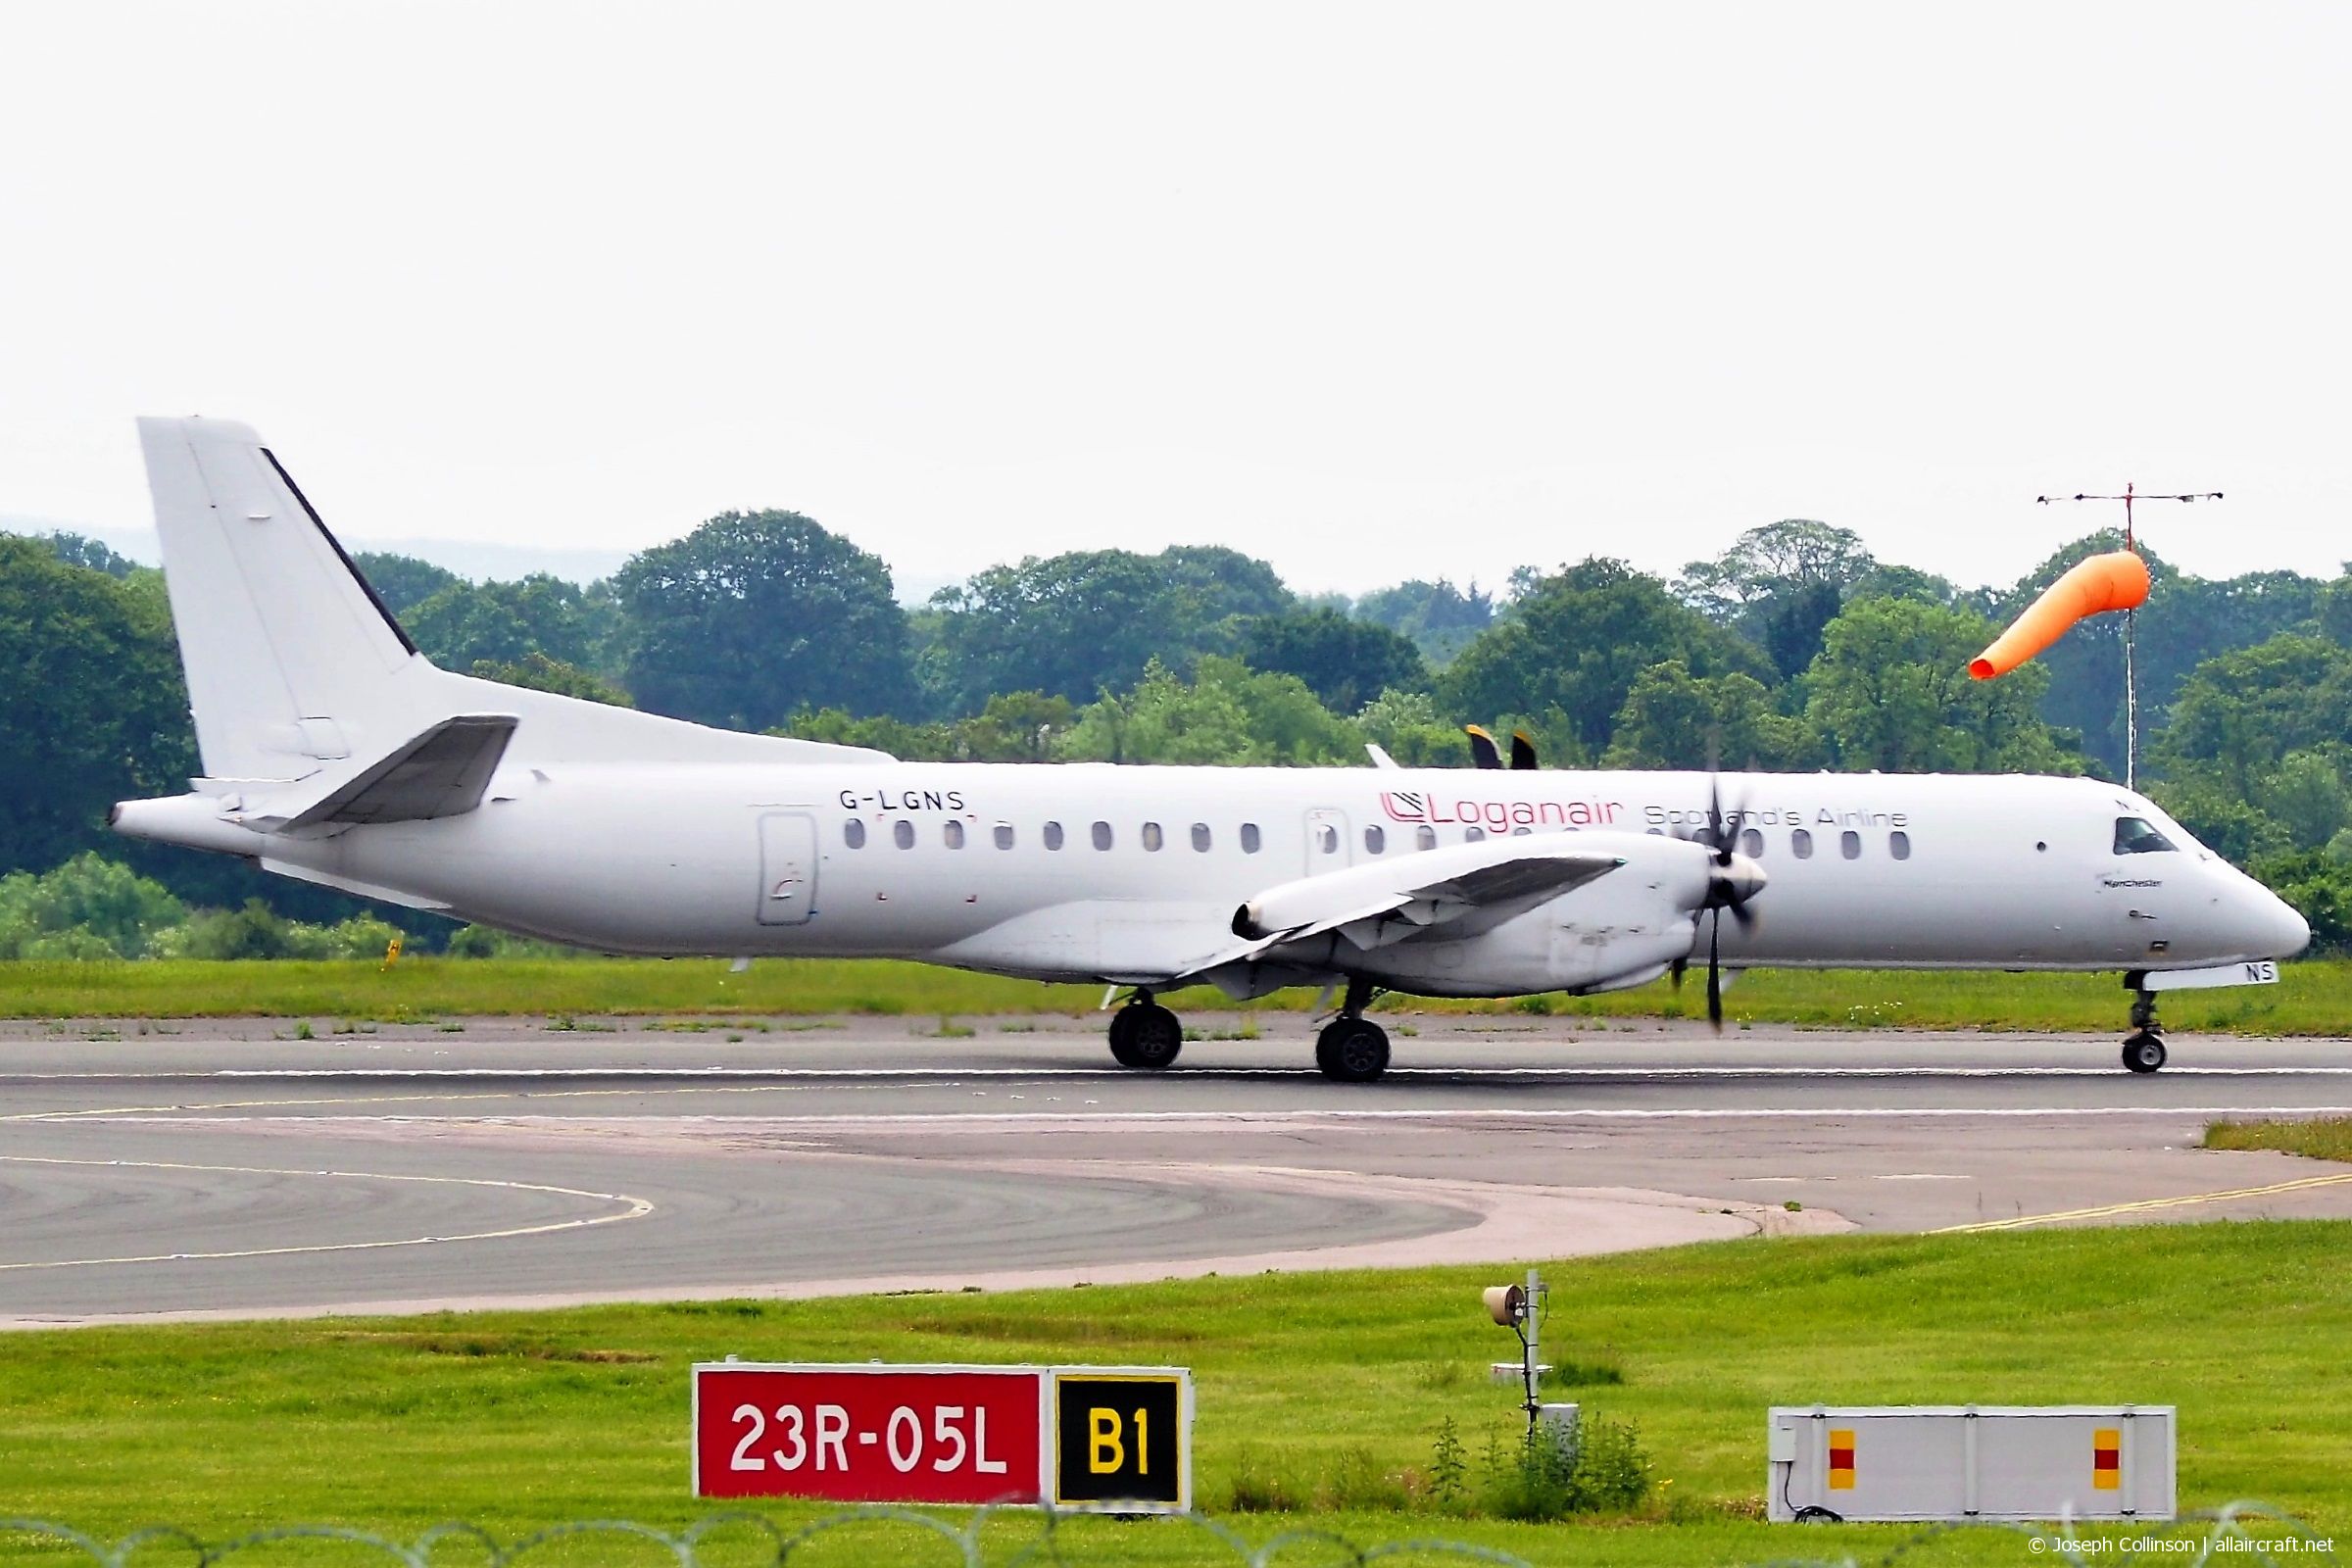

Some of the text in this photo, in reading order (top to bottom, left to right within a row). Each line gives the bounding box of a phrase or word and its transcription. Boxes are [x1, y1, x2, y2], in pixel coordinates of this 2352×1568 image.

[840, 790, 963, 810] G-LGNS
[1427, 793, 1623, 833] Loganair
[1817, 808, 1908, 827] Airline
[2246, 963, 2274, 981] NS
[730, 1403, 1007, 1474] 23R-05L
[1089, 1407, 1149, 1475] B1
